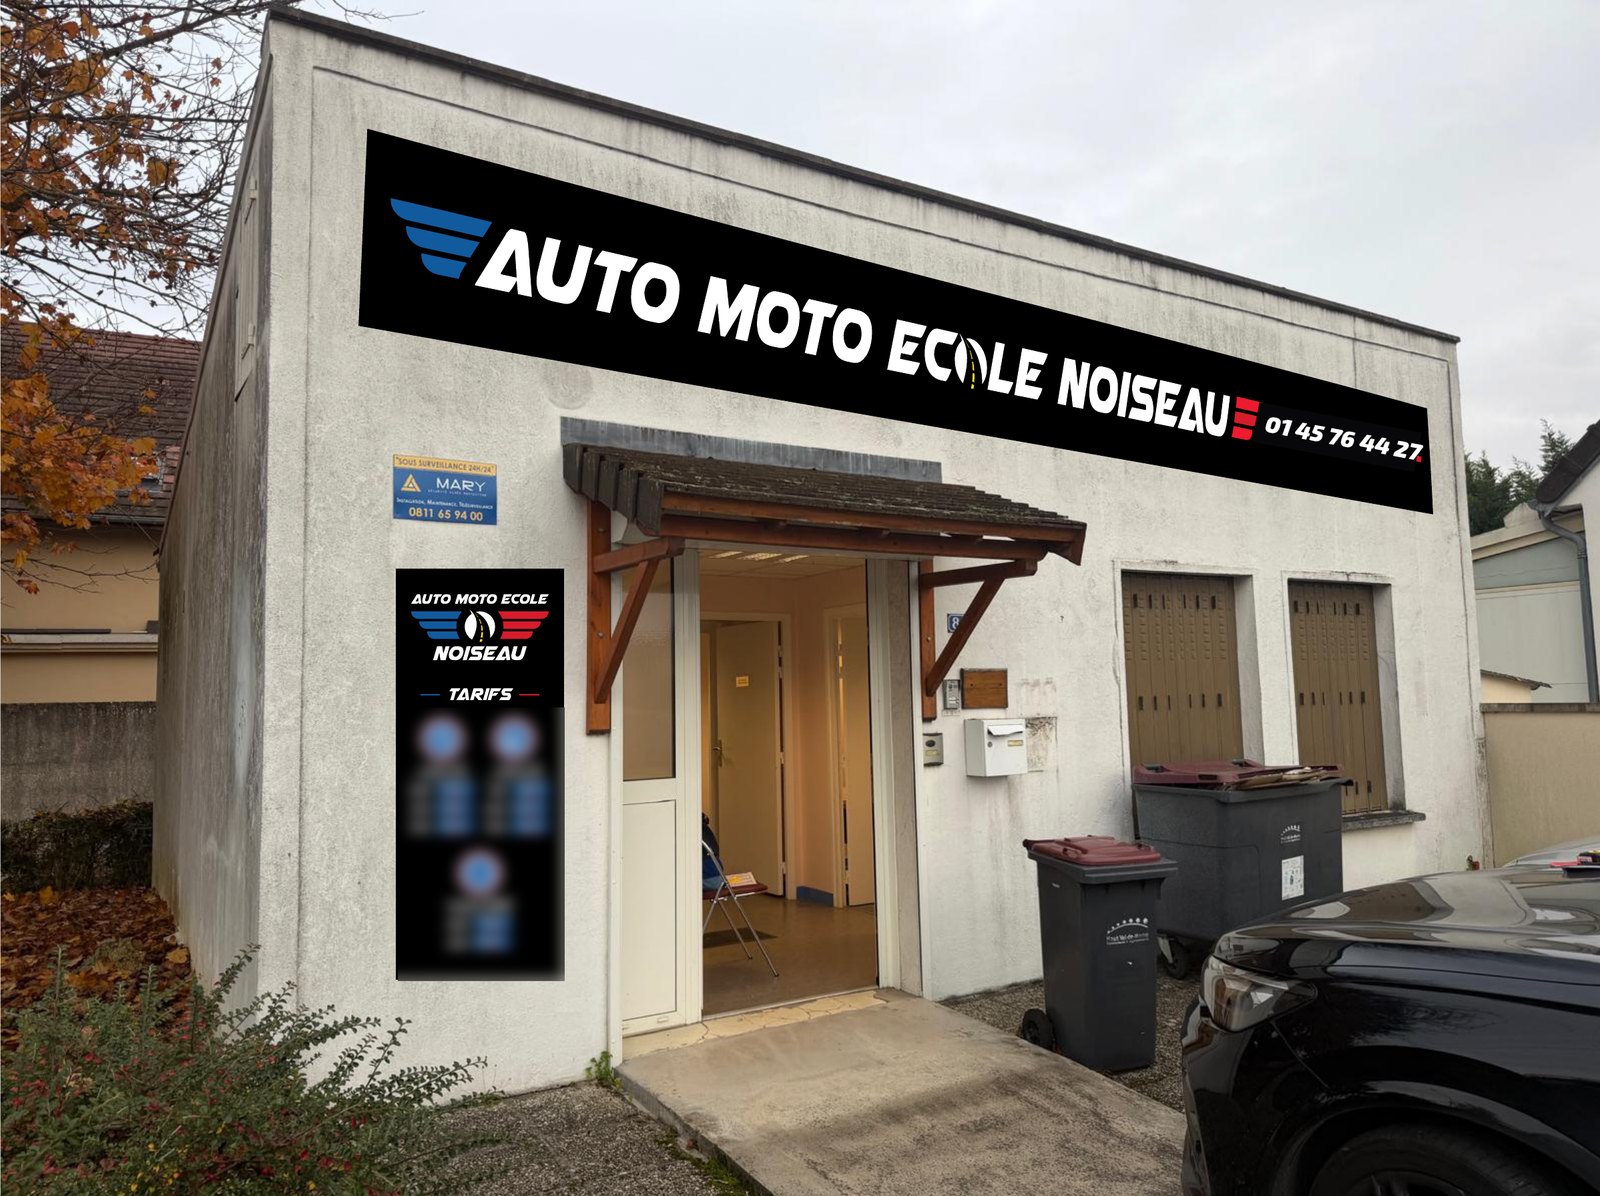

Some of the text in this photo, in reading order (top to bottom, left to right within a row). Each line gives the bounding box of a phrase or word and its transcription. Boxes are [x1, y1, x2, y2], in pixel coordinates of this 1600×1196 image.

[475, 228, 1231, 437] AUTO MOTO ECOLE NOISEAU
[1265, 416, 1293, 437] 01
[1294, 422, 1326, 442] 45
[1329, 427, 1356, 448] 76
[1359, 434, 1390, 455] 44
[419, 459, 467, 471] SURVEILLANCE
[436, 477, 486, 492] MARY
[409, 507, 483, 521] 0811 65 94 00
[411, 593, 549, 604] AUTO MOTO ECOLE
[433, 646, 527, 661] NOISEAU
[450, 688, 513, 701] TARIFS
